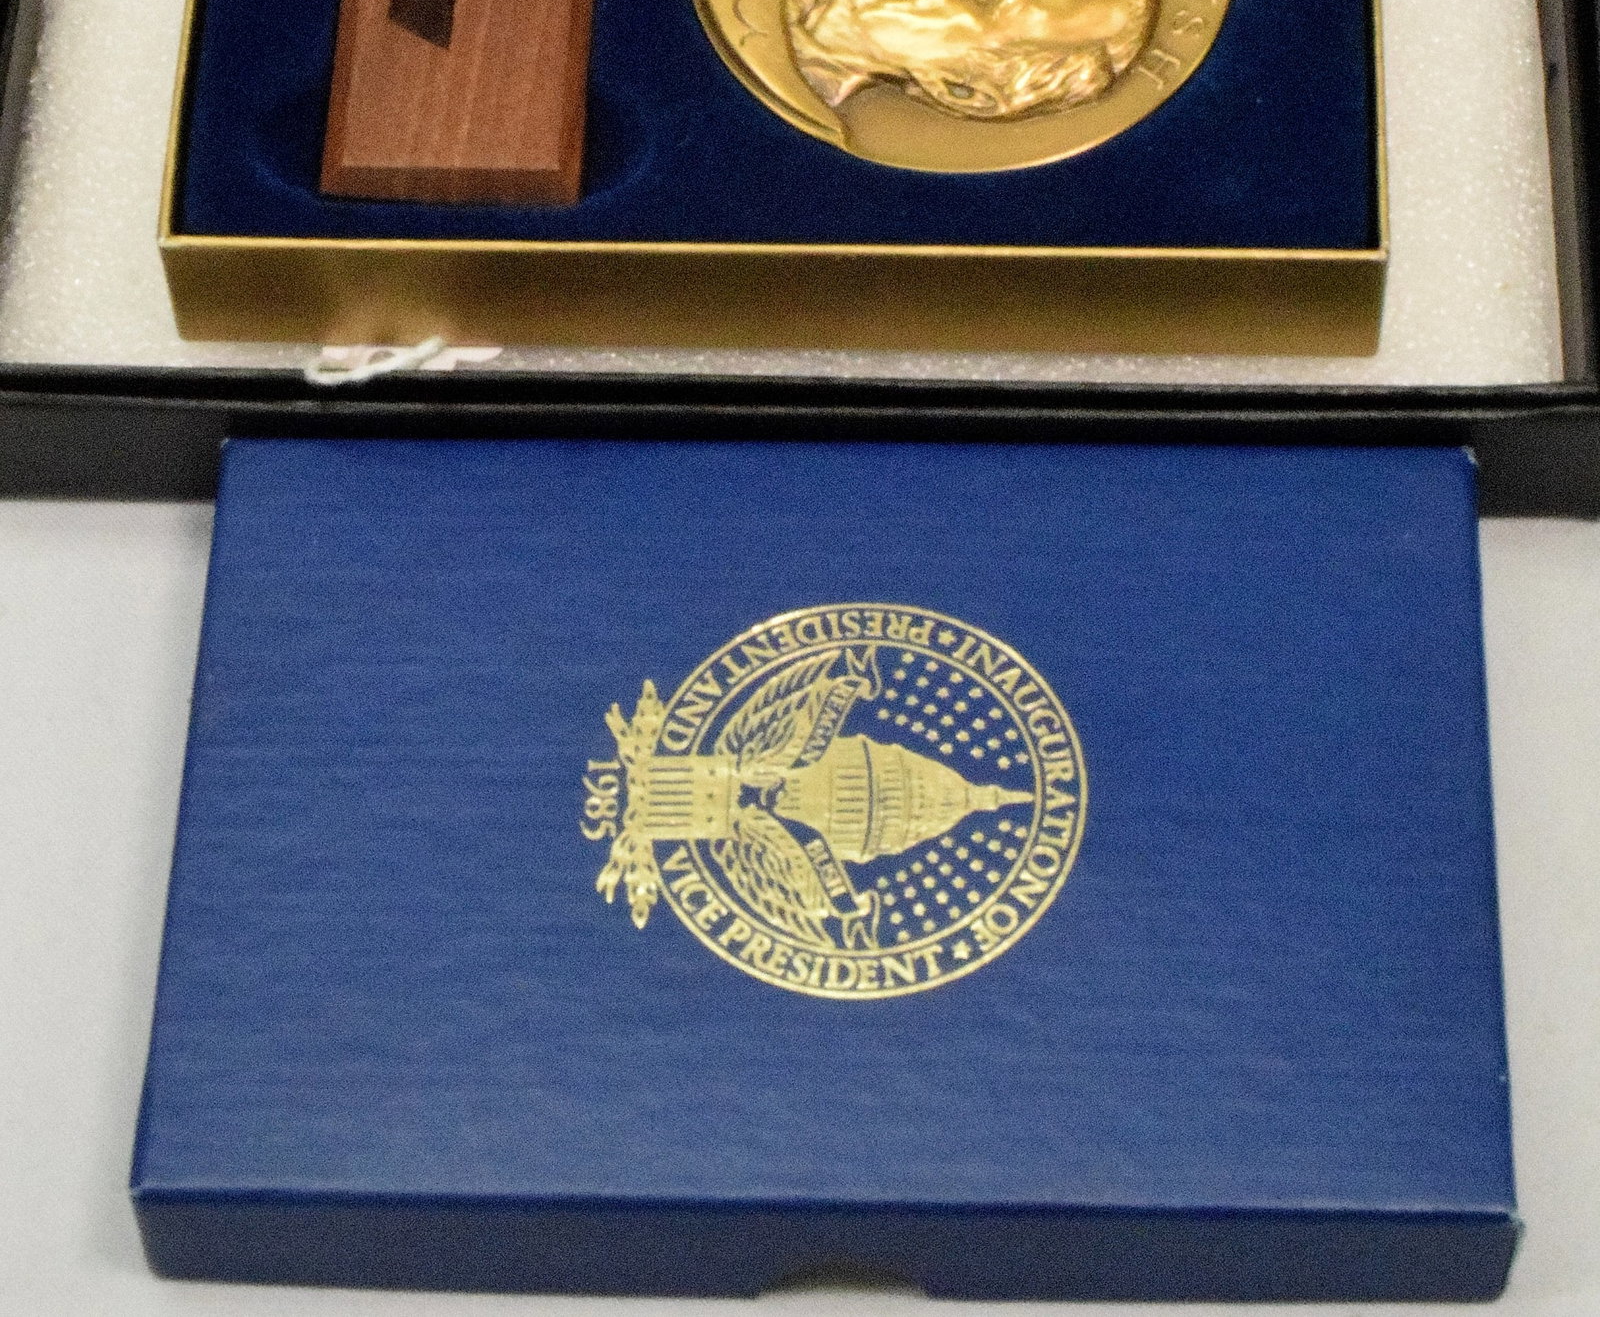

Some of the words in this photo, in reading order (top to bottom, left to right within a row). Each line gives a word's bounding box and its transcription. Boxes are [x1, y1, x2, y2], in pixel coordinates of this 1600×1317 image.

[721, 610, 936, 684] PRESIDENT
[661, 670, 723, 751] AND
[579, 759, 622, 841] 1985
[951, 635, 1077, 909] INAUGURATION
[805, 839, 848, 898] BUSH
[661, 845, 729, 930] VICE
[717, 925, 944, 990] PRESIDENT
[970, 902, 1019, 952] OF
